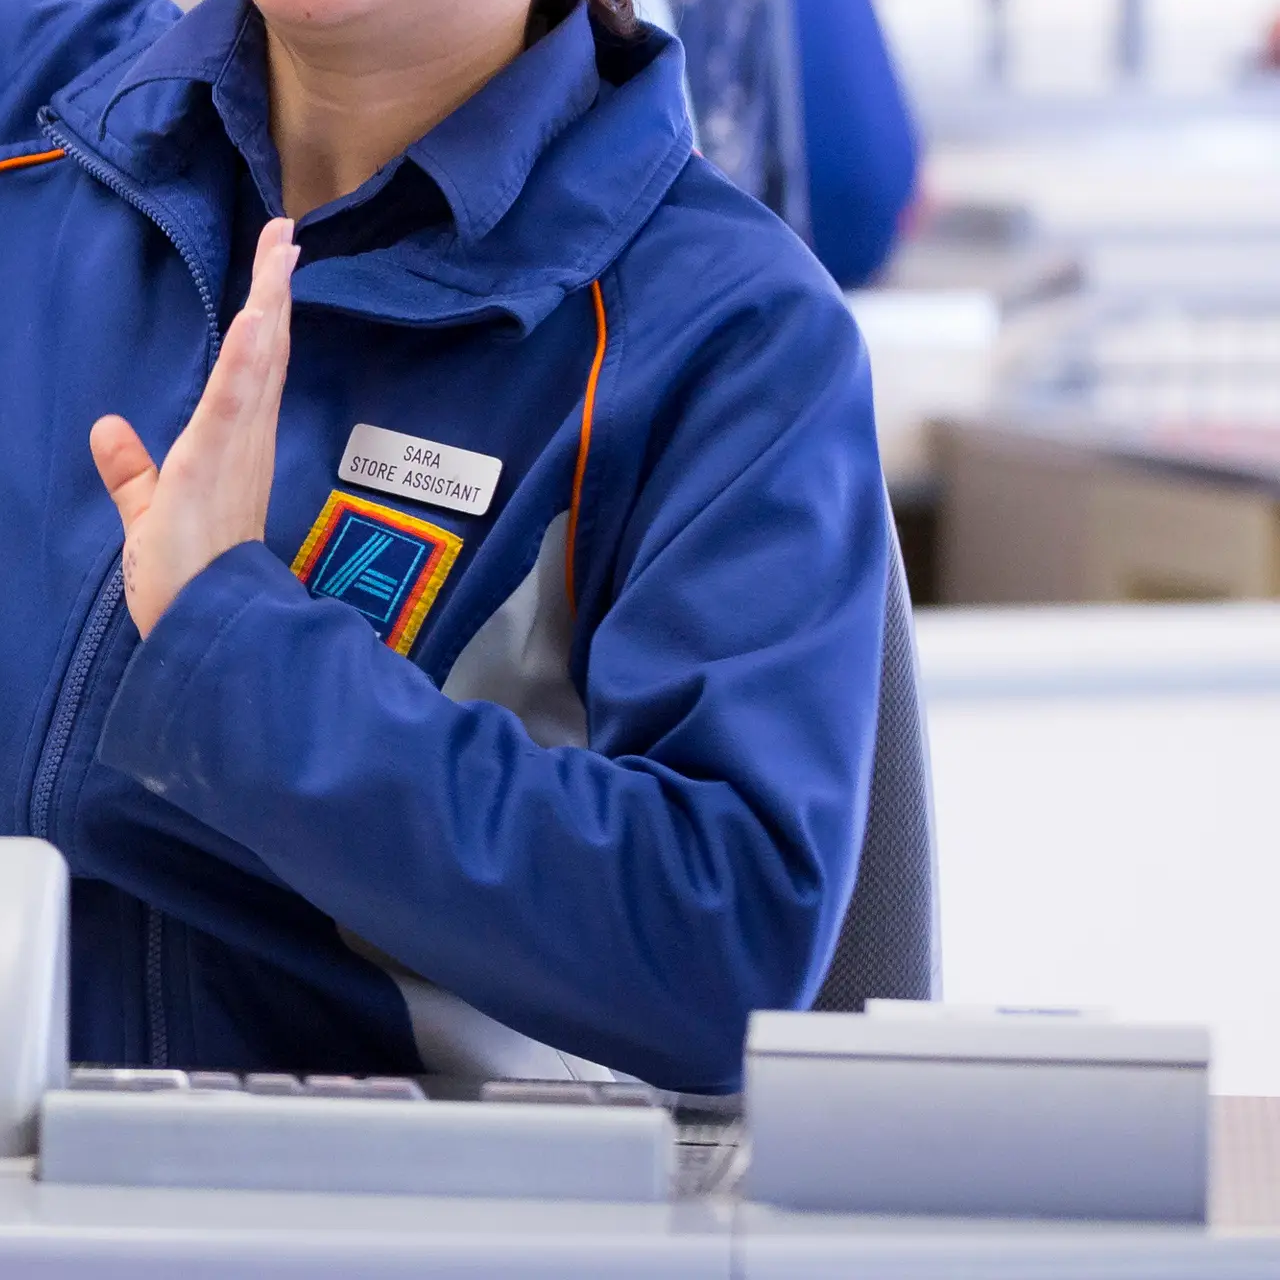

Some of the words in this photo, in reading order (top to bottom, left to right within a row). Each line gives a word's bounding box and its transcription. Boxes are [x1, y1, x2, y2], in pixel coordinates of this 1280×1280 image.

[403, 445, 441, 469] SARA
[350, 456, 398, 482] STORE
[402, 470, 482, 503] ASSISTANT
